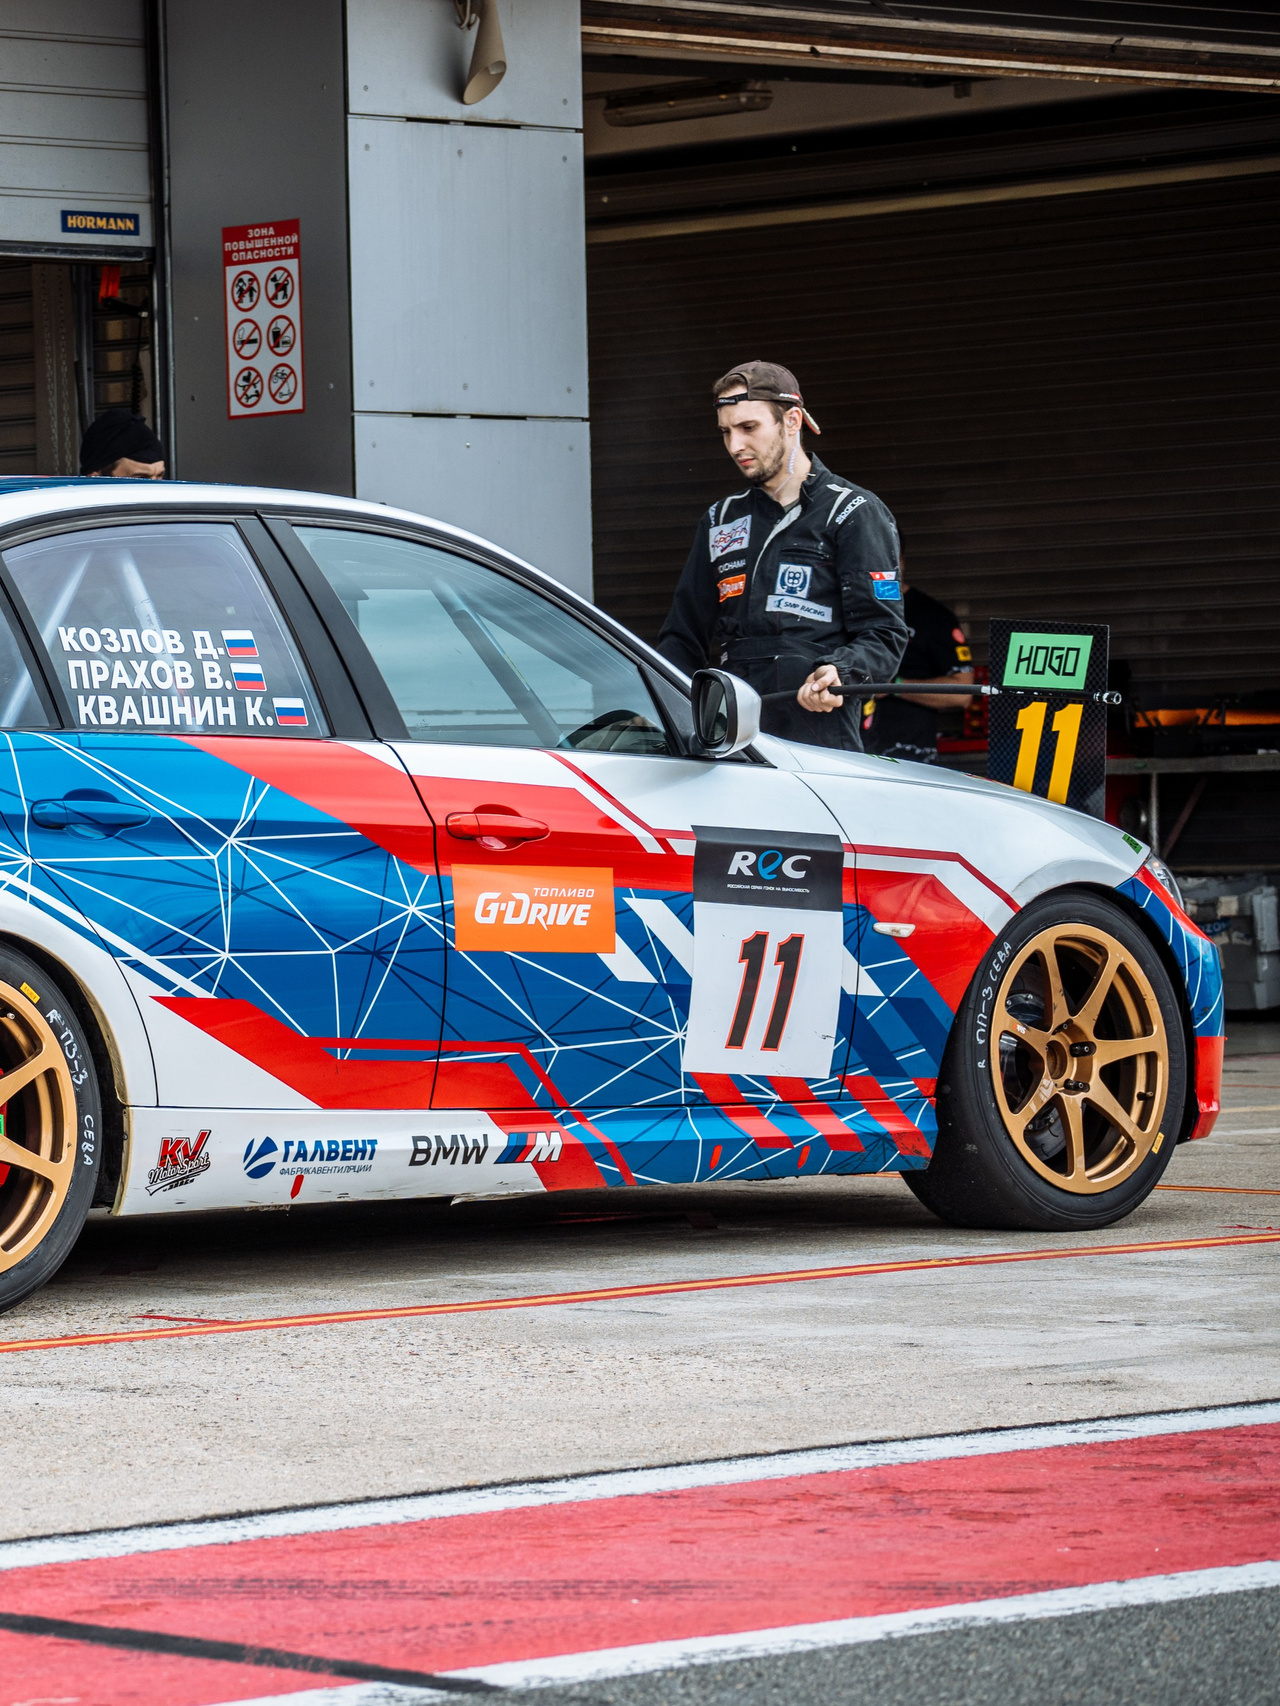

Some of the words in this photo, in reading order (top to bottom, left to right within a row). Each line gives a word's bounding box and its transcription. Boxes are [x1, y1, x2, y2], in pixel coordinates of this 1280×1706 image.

[224, 233, 299, 252] ПОВЫШЕННОЙ
[247, 226, 275, 238] ЗОНА
[231, 245, 295, 262] ОПАСНОСТИ
[835, 495, 867, 525] sparco
[783, 601, 800, 610] SMP
[800, 605, 825, 617] RACING
[57, 626, 186, 655] КОЗЛОВ
[193, 629, 225, 661] Д.
[67, 659, 195, 690] ПРАХОВ
[202, 661, 233, 691] В.
[1015, 645, 1081, 677] HOGO
[76, 694, 237, 727] КВАШНИН
[246, 696, 275, 727] К.
[1013, 701, 1084, 805] 11
[533, 887, 595, 898] ТОПЛИВО
[724, 930, 805, 1052] 11
[158, 1129, 212, 1169] KV
[282, 1139, 378, 1163] ГАЛВЕНТ
[408, 1133, 489, 1168] BMW
[523, 1131, 563, 1163] M
